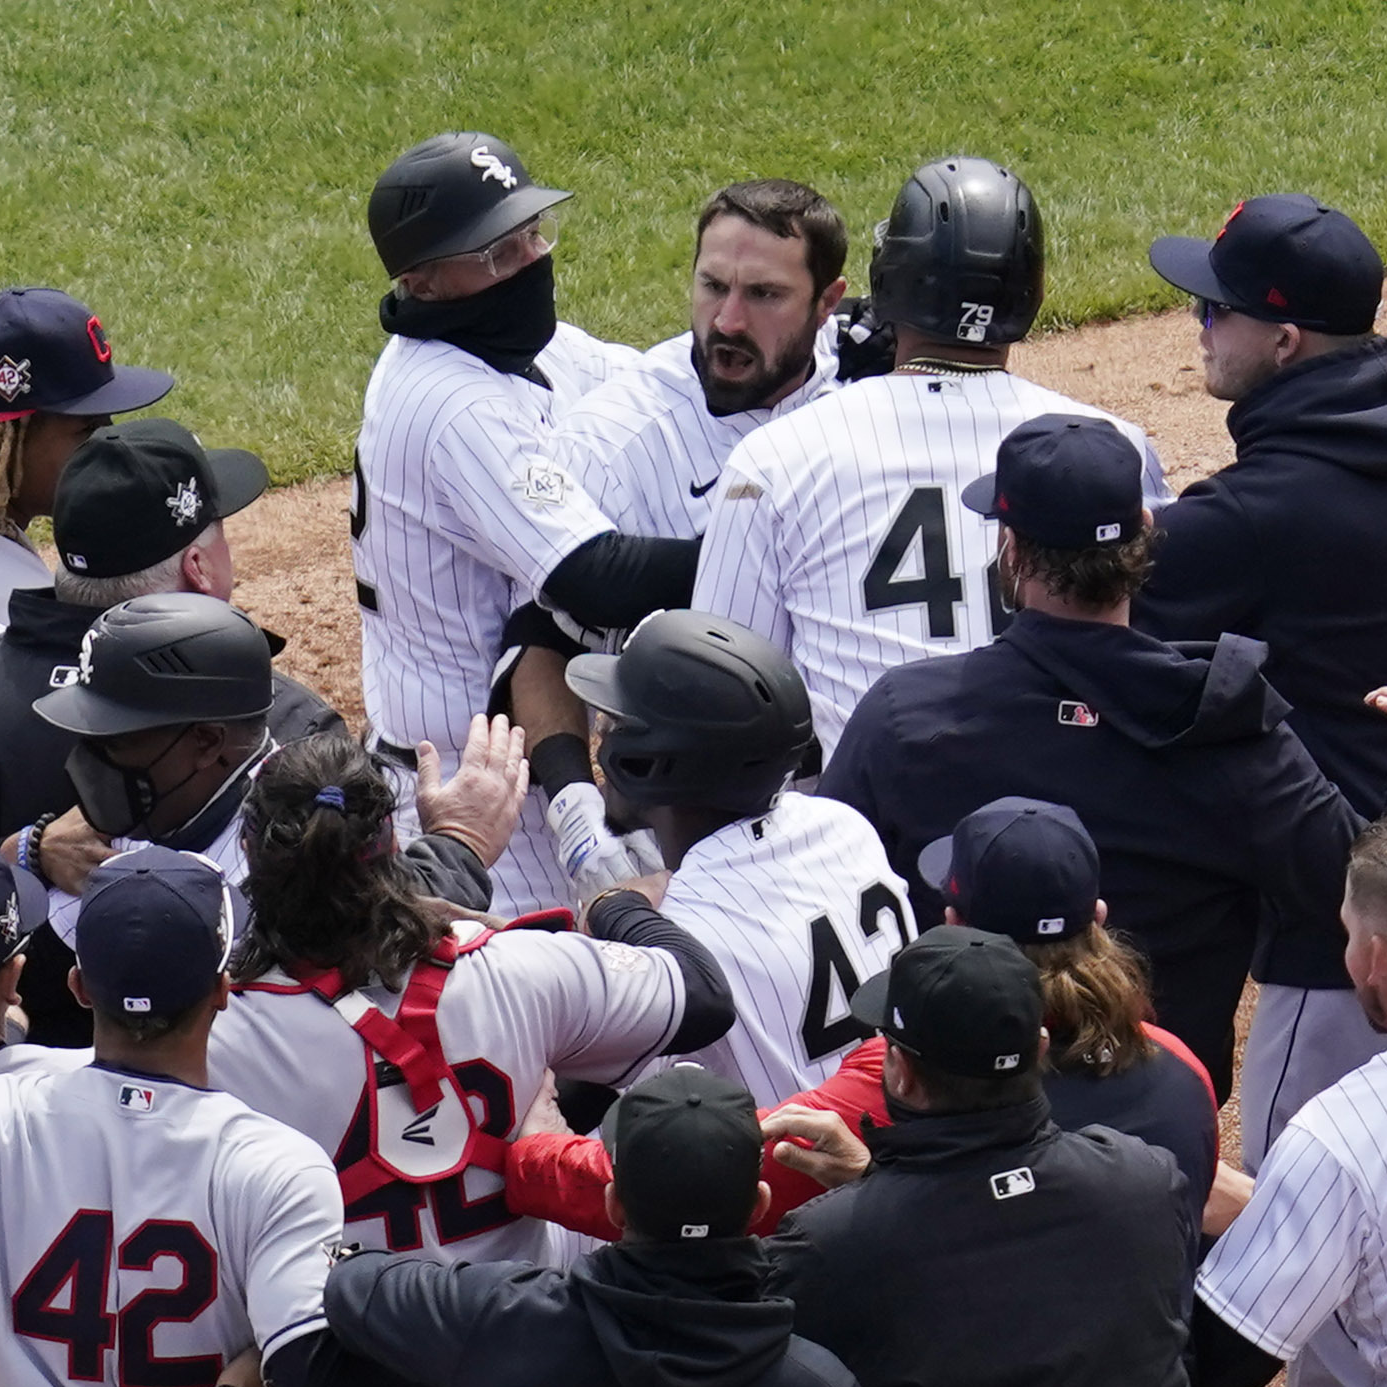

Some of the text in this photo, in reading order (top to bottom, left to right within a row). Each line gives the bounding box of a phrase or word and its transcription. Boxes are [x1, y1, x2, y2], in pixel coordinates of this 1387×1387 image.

[961, 302, 994, 326] 79
[87, 315, 112, 362] C
[535, 473, 557, 492] 42
[861, 482, 1016, 642] 4
[796, 878, 912, 1066] 42
